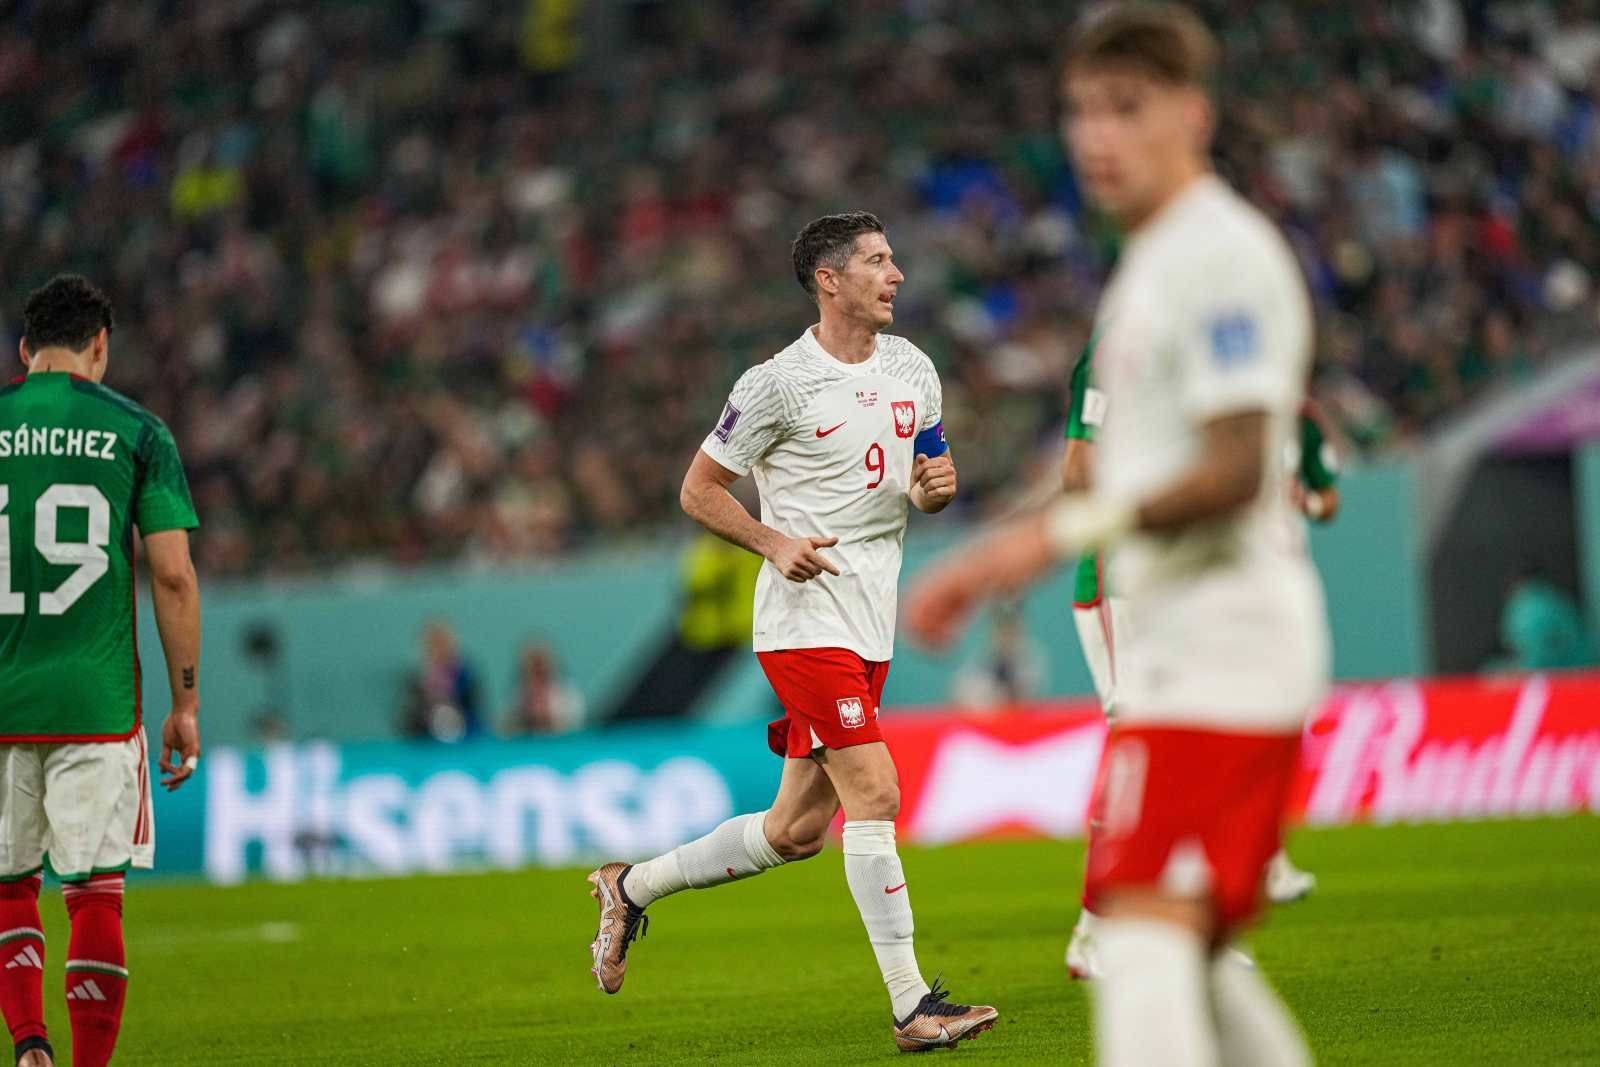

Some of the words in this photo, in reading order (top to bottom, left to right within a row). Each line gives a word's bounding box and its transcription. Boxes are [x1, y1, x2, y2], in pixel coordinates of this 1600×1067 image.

[0, 423, 118, 461] SÁNCHEZ
[864, 442, 885, 490] 9
[204, 741, 732, 886] Hisense
